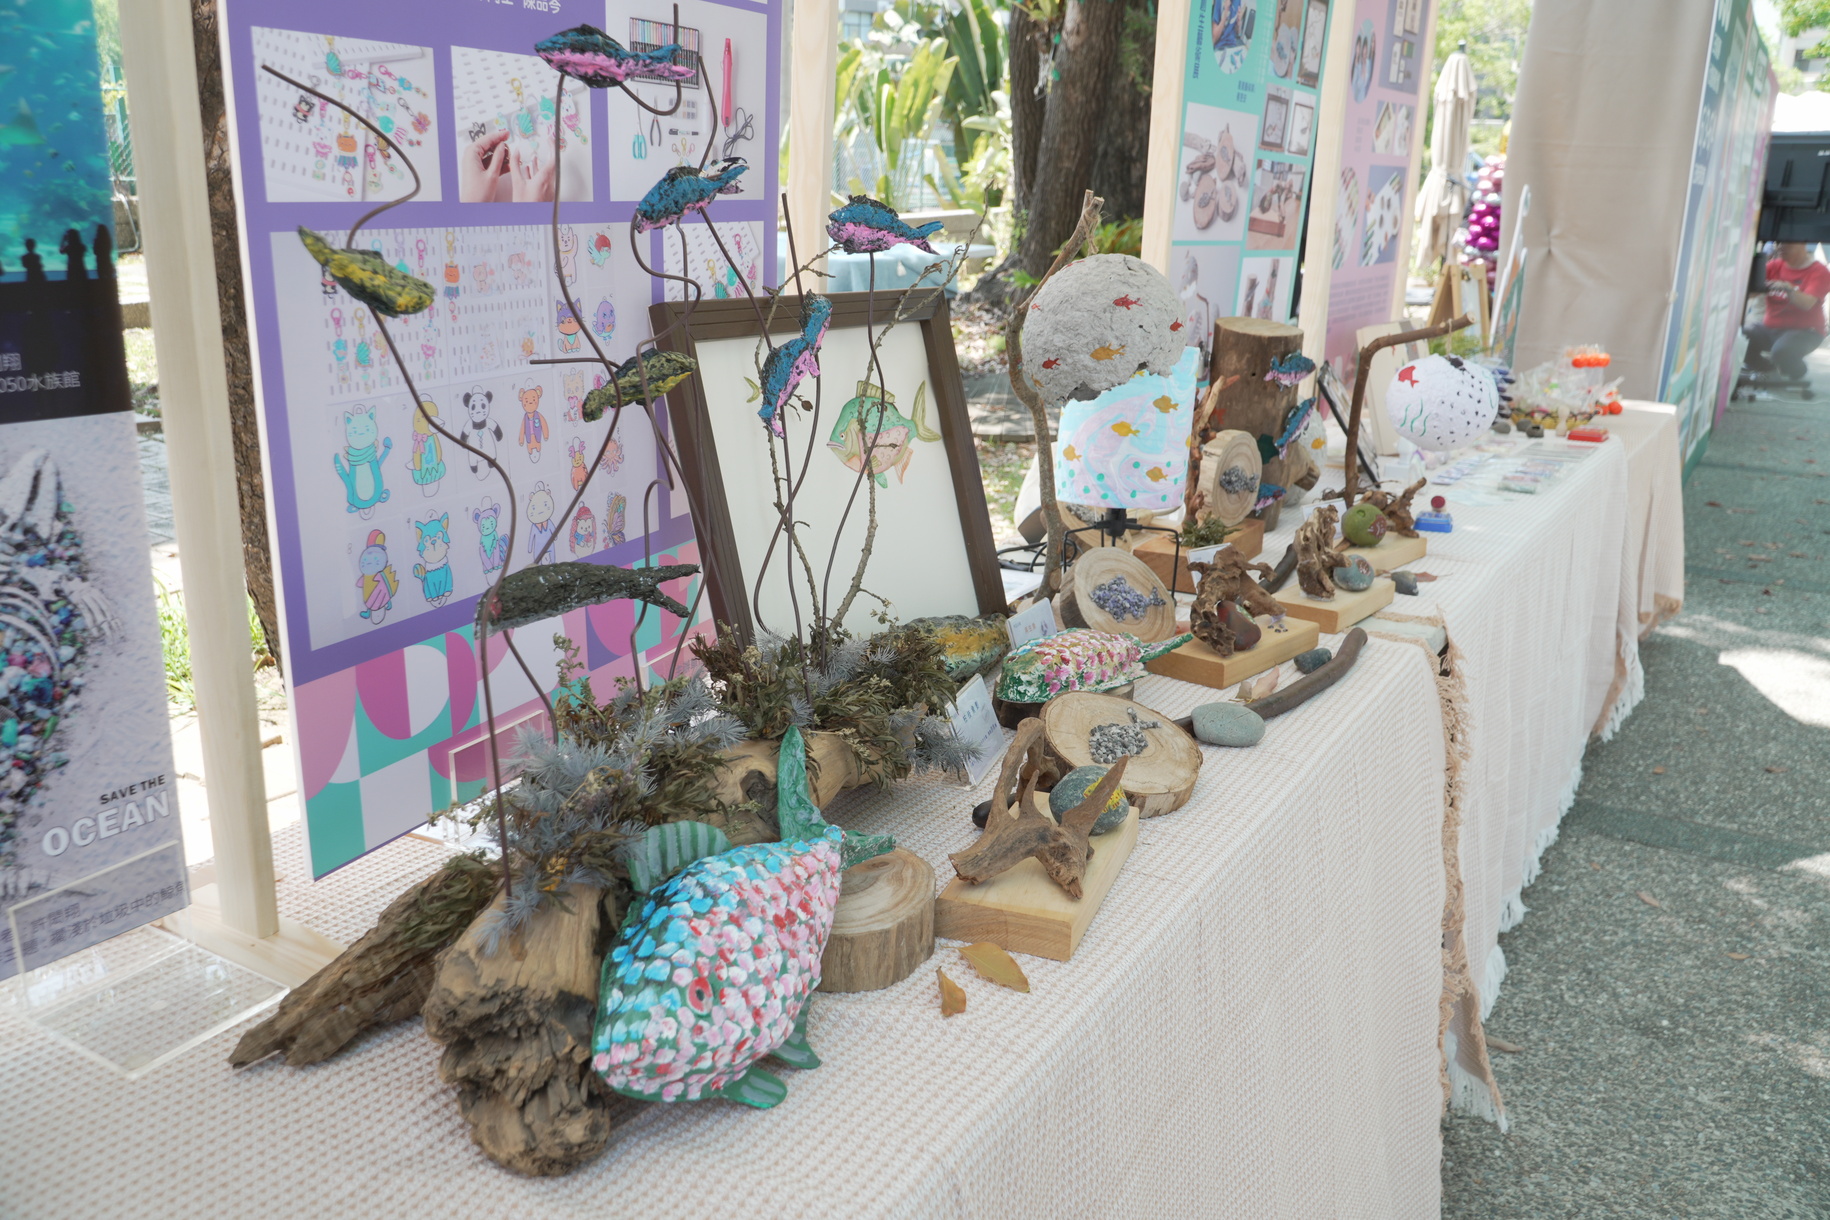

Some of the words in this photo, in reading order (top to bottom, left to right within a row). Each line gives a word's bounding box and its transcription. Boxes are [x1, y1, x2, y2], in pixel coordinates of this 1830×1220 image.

[100, 784, 137, 805] SAVE
[140, 774, 166, 791] THE
[41, 790, 170, 857] OCEAN
